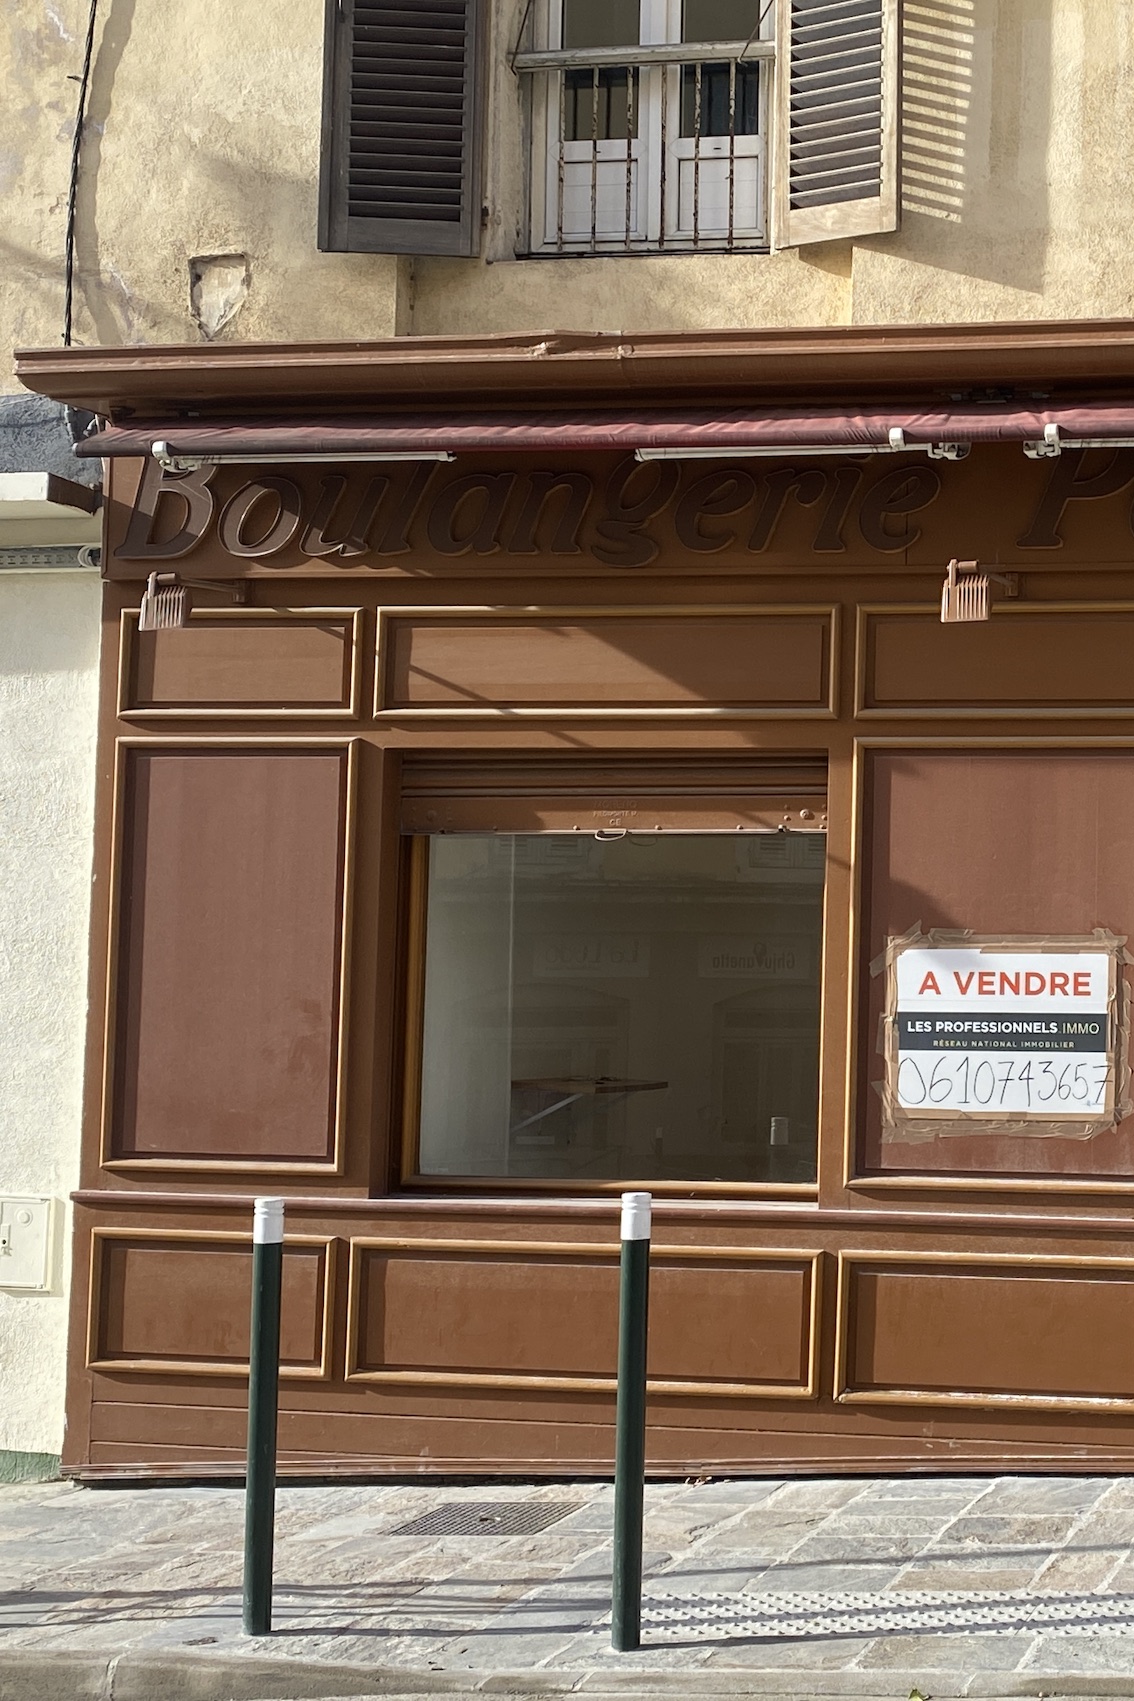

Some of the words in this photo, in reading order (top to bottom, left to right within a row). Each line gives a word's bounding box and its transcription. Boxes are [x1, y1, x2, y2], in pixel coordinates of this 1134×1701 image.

[114, 455, 942, 568] Boulangerie
[918, 971, 941, 995] A
[953, 971, 1092, 996] VENDRE
[907, 1021, 932, 1033] LES
[971, 1040, 1017, 1048] NATIONAL
[1020, 1041, 1075, 1049] IMMOBILIER
